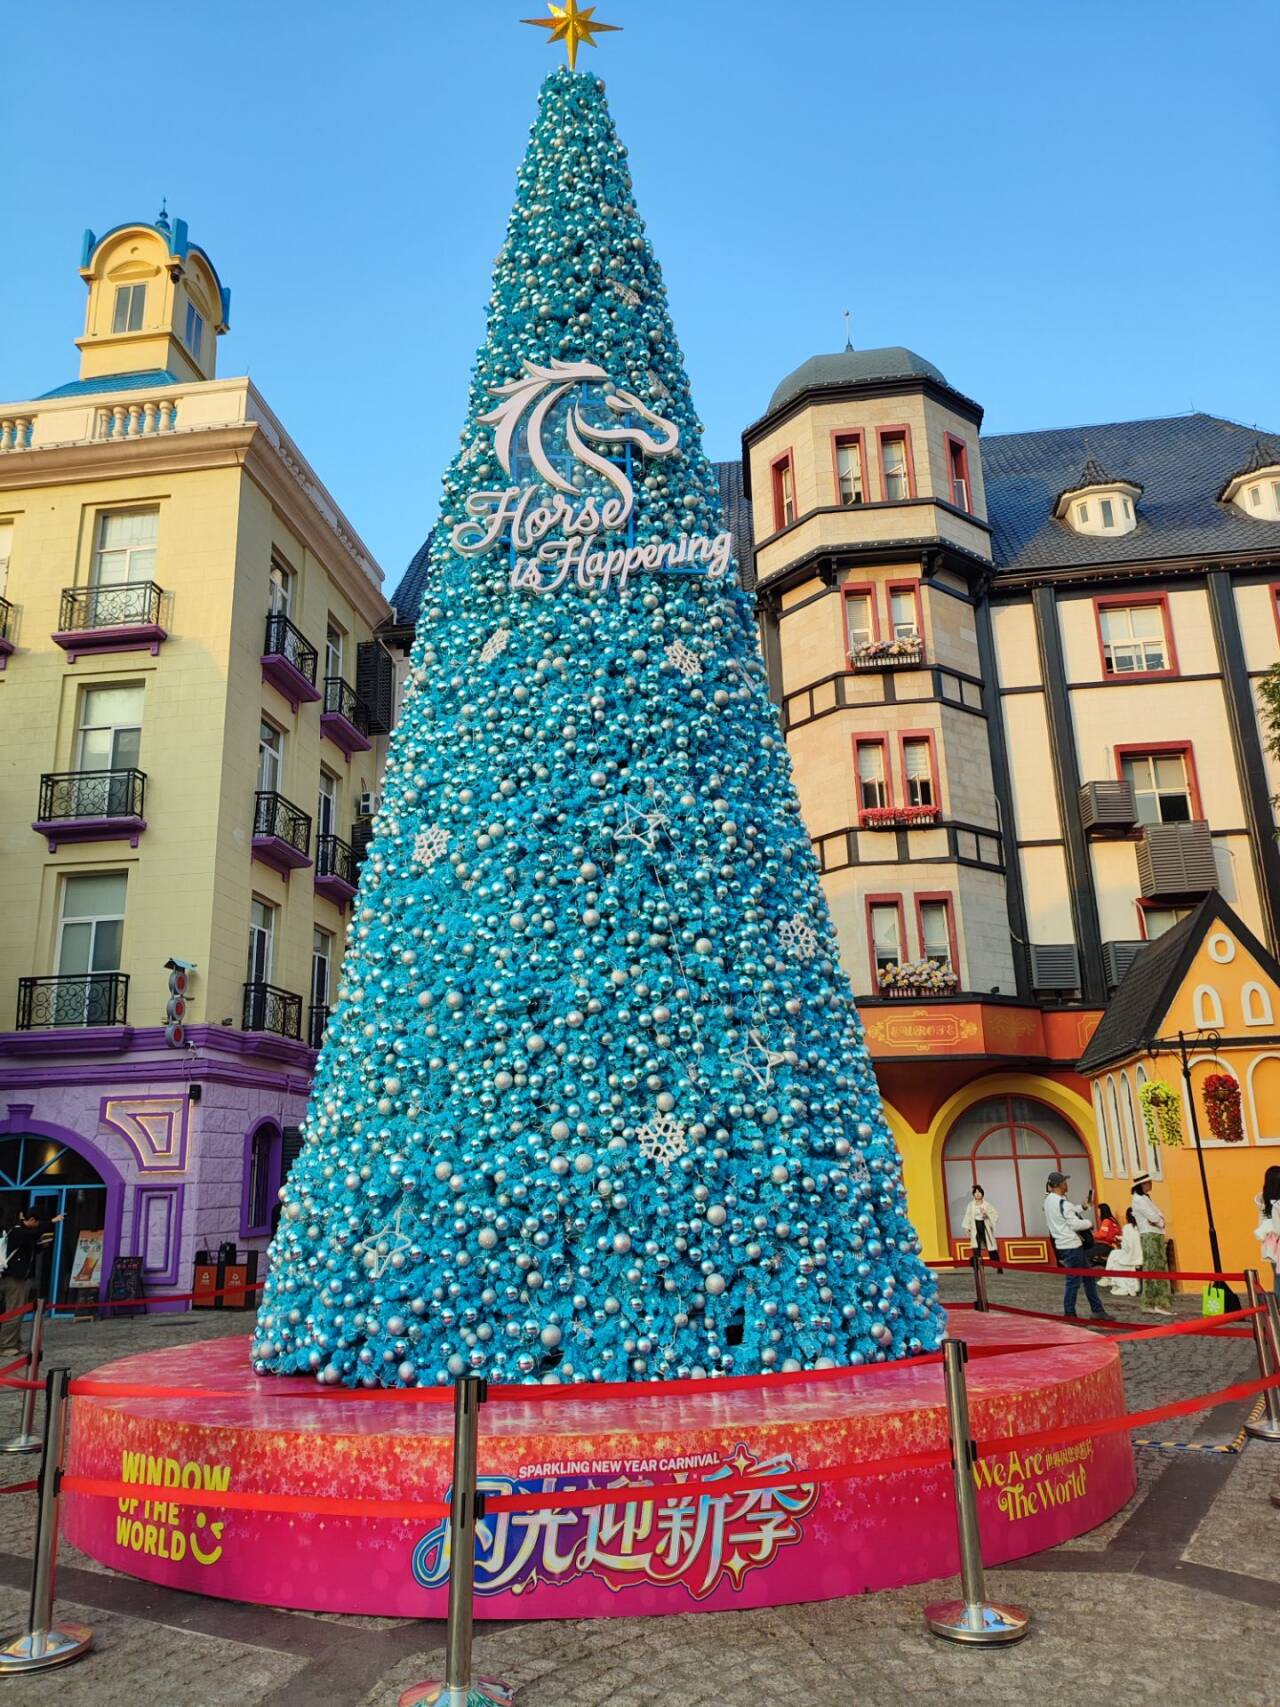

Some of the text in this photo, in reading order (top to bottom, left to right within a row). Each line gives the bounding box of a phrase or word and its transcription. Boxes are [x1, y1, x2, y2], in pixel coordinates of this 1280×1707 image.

[450, 484, 630, 557] Horse
[511, 531, 732, 594] is Happening
[122, 1449, 232, 1492] WINDOW
[519, 1452, 721, 1479] SPARKLING NEW YEAR CARNIVAL
[971, 1457, 1006, 1491] We
[1006, 1449, 1044, 1484] Are
[997, 1463, 1087, 1521] The World
[116, 1515, 187, 1561] WORLD
